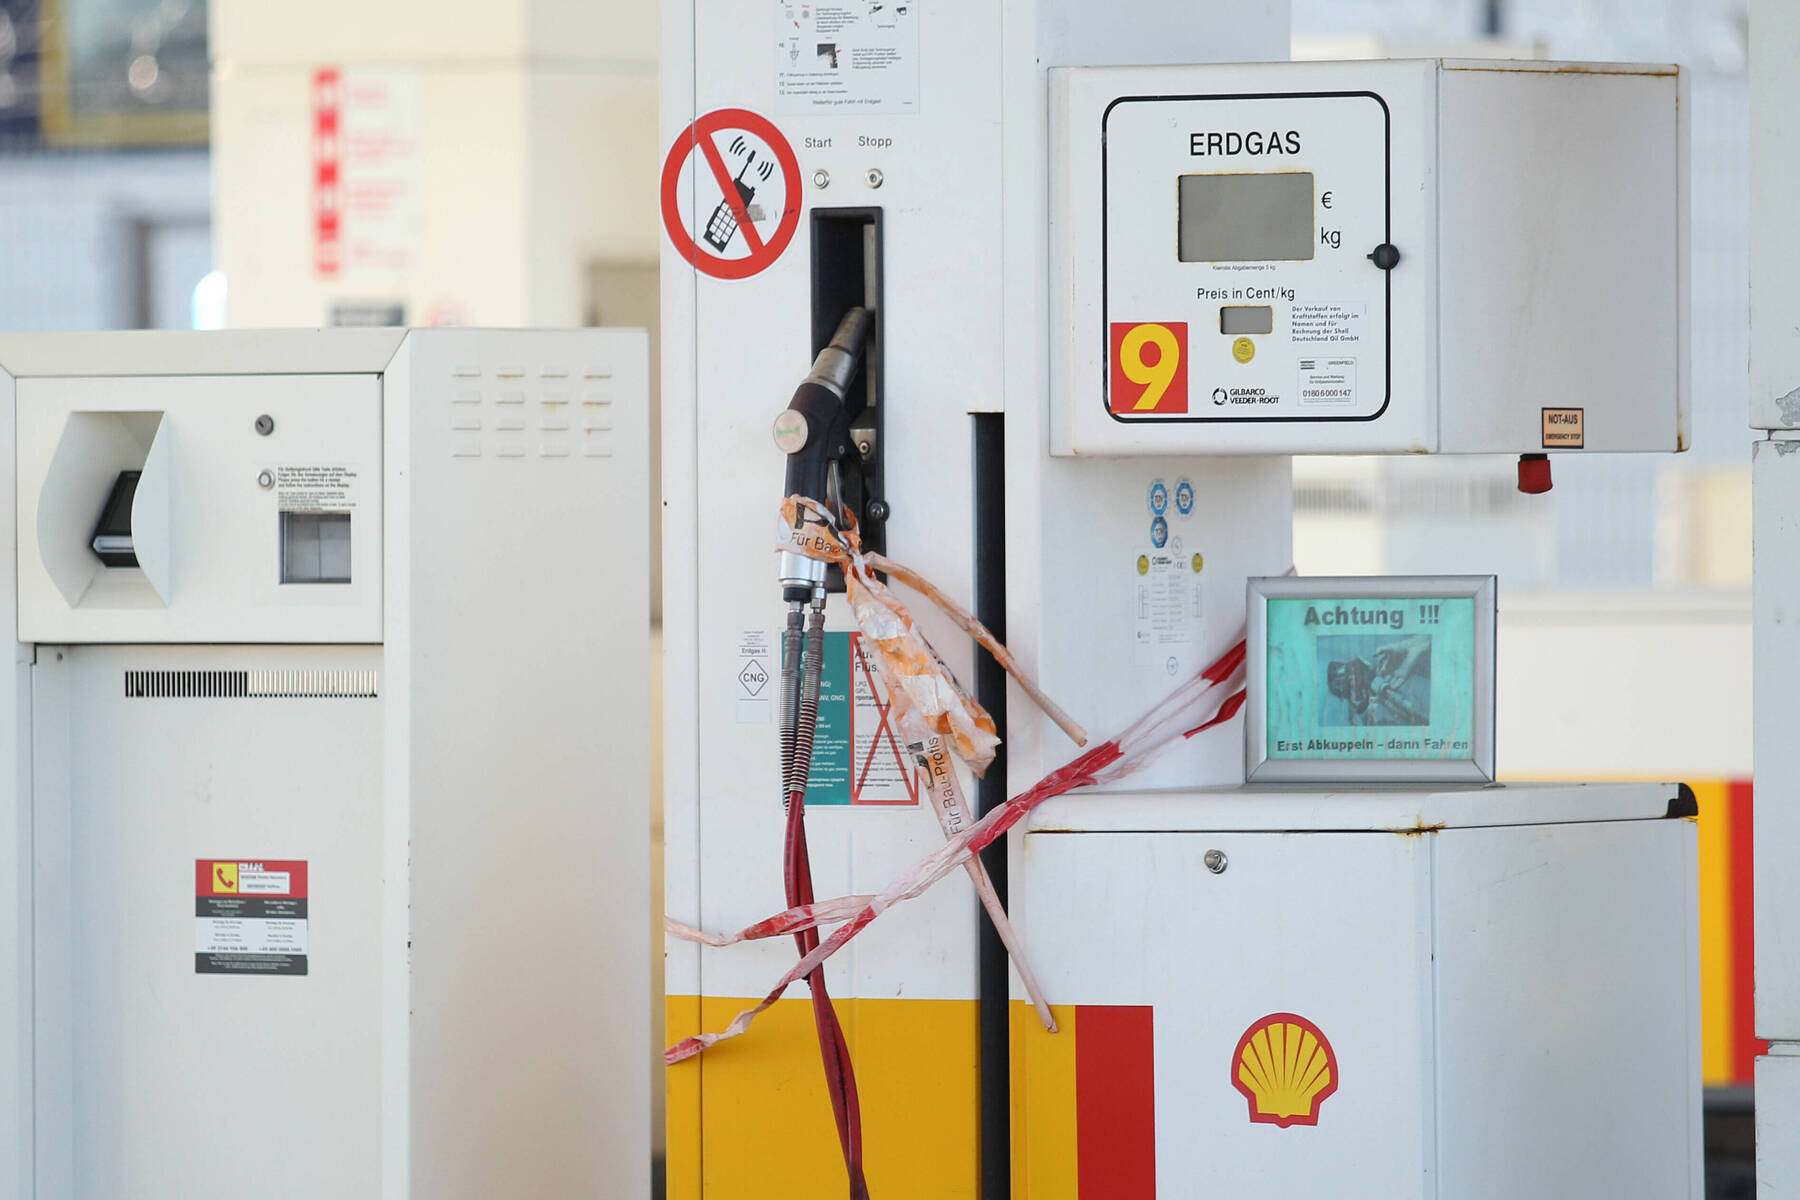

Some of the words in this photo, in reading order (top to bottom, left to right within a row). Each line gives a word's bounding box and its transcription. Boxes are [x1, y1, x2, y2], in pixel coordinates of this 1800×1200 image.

[805, 138, 832, 148] Start
[858, 136, 892, 148] Stopp
[1190, 131, 1301, 156] ERDGAS
[1321, 192, 1332, 209] €
[1320, 227, 1341, 249] kg
[1197, 288, 1228, 299] Preis
[1232, 288, 1242, 299] in
[1246, 287, 1295, 301] Cent/kg
[1120, 324, 1180, 410] 9
[1549, 414, 1577, 424] NOT-AUS
[1304, 606, 1404, 629] Achtung
[1419, 605, 1439, 624] !!!
[743, 673, 764, 683] CNG
[1277, 740, 1303, 752] Erst
[1307, 740, 1374, 752] Abkuppeln
[1387, 738, 1419, 750] dann
